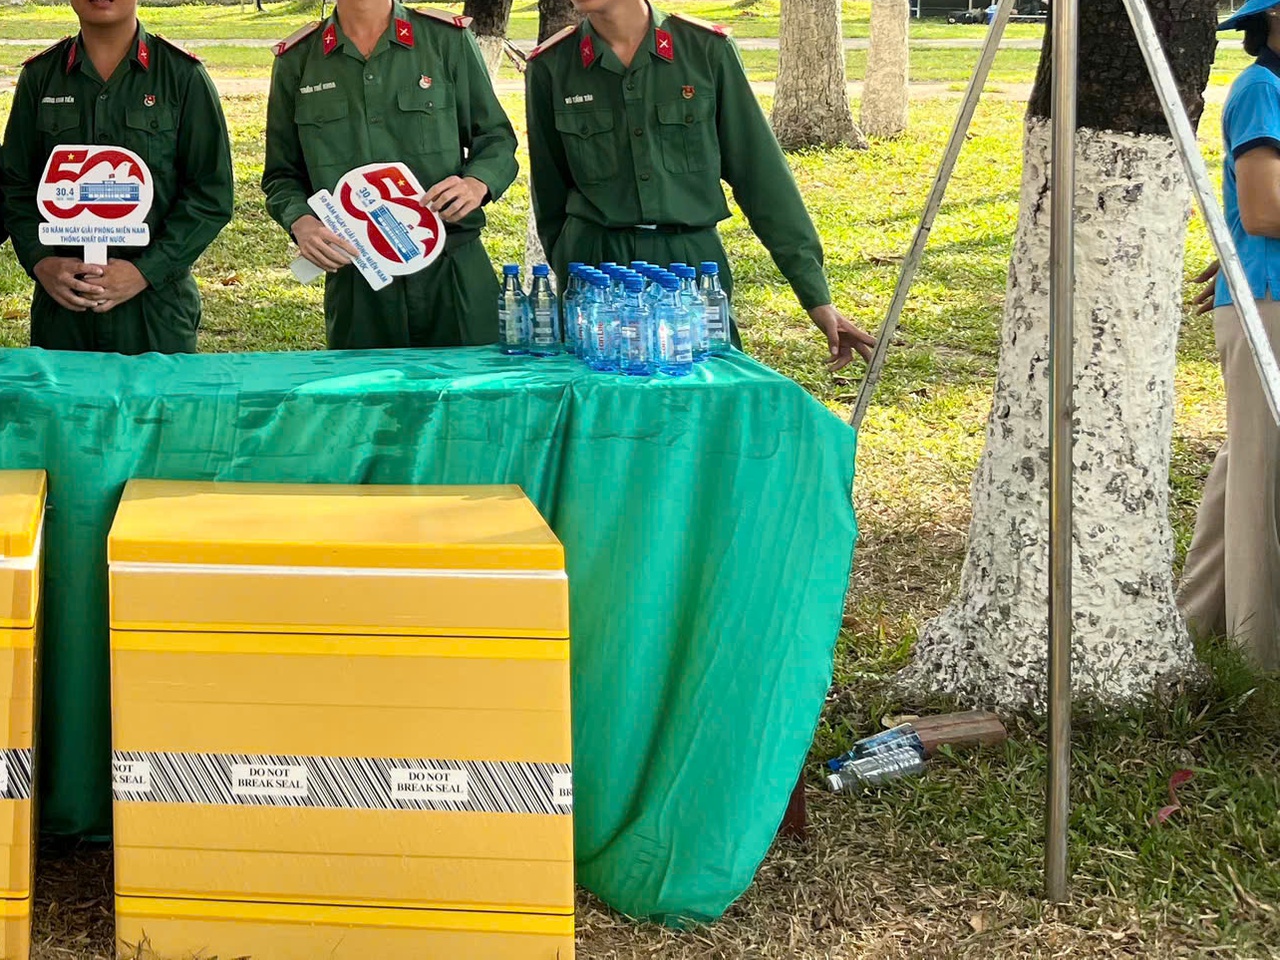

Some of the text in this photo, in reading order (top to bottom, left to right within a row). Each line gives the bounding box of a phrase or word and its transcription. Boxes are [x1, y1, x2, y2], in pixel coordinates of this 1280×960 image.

[56, 188, 74, 196] 30.4
[359, 187, 376, 205] 30.4
[249, 768, 290, 778] DO NOT
[409, 772, 450, 782] DO NOT
[120, 775, 146, 784] SEAL
[238, 778, 303, 789] BREAK SEAL
[397, 783, 463, 794] BREAK SEAL
